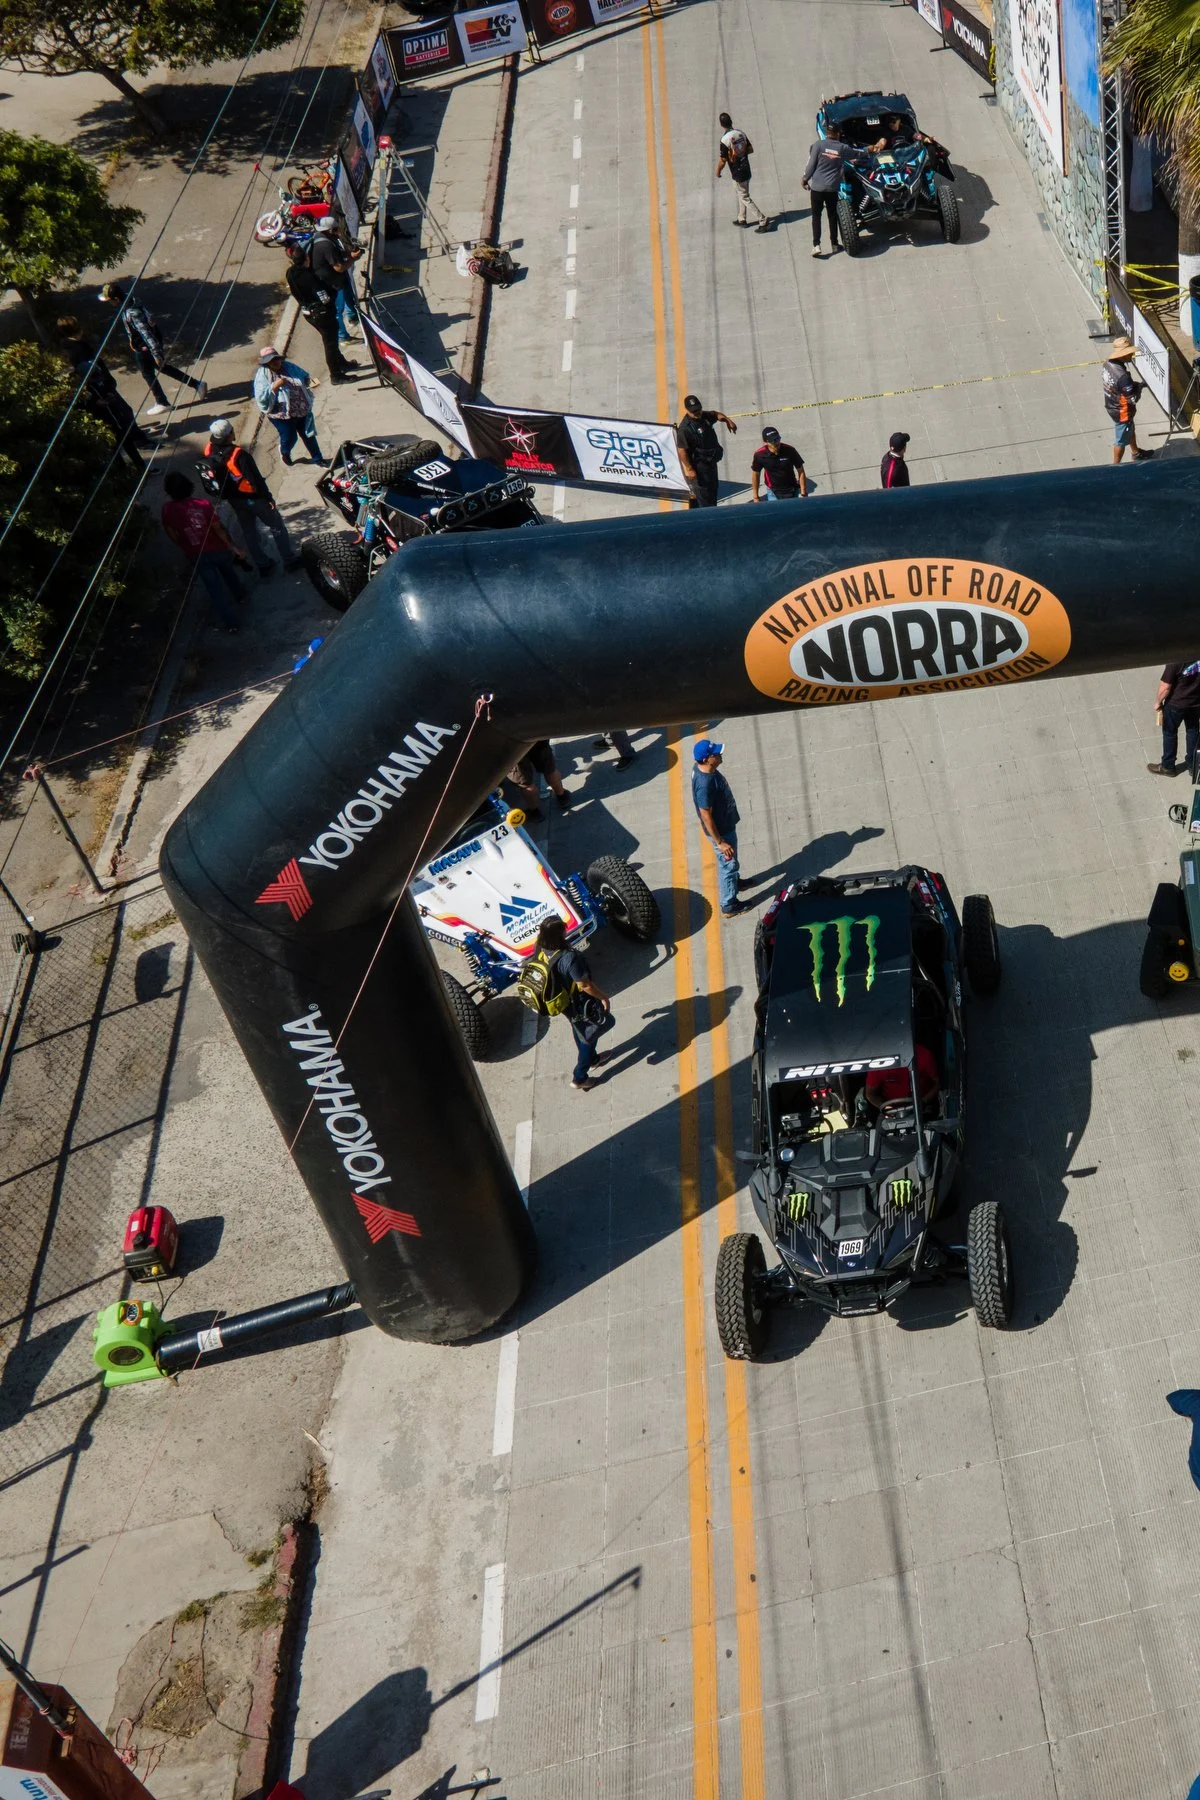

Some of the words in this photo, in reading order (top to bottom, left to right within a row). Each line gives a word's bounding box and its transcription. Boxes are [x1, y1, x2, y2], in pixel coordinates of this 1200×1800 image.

[405, 31, 447, 55] OPTIMA
[952, 16, 988, 61] YOKOHAMA
[586, 428, 662, 458] Sign
[417, 462, 449, 479] 136
[602, 447, 666, 475] Art
[507, 479, 524, 494] 136
[762, 568, 895, 645] NATIONAL
[907, 564, 955, 597] OFF
[968, 567, 1042, 617] ROAD
[801, 607, 1023, 684] NORRA
[776, 677, 871, 703] RACING
[898, 650, 1051, 698] ASSOCIATION
[299, 720, 456, 871] YOKOHAMA
[491, 824, 510, 843] 23
[784, 1056, 897, 1080] NITTO
[282, 1009, 392, 1194] YOKOHAMA
[839, 1240, 862, 1256] 1969
